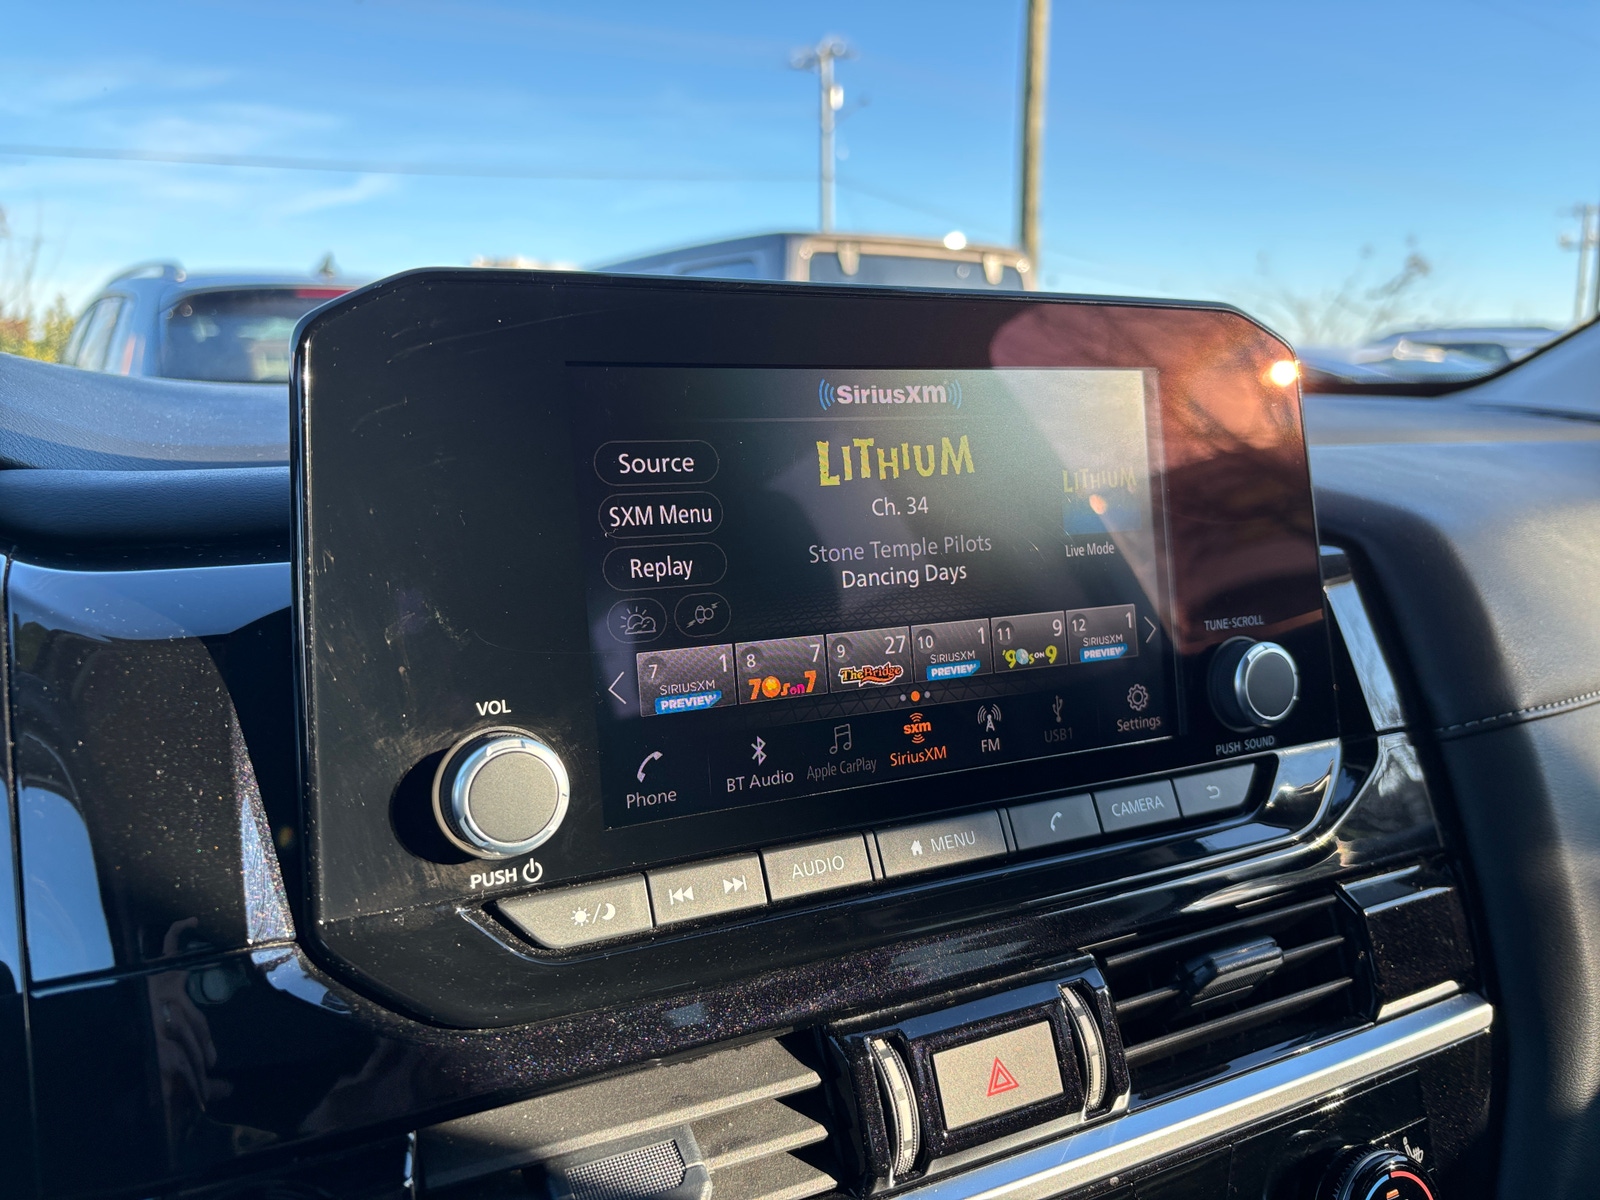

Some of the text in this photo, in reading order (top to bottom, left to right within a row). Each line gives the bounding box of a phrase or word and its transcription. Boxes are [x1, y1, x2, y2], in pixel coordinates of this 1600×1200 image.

[618, 453, 694, 473] Source
[872, 496, 929, 516] Ch. 34
[609, 504, 712, 527] SXM Menu
[809, 533, 992, 563] Stone Temple Pilots
[1065, 541, 1115, 557] Live Mode
[630, 555, 693, 582] Replay
[842, 563, 967, 590] Dancing Days
[1052, 619, 1063, 637] 9
[1071, 619, 1087, 633] 12
[1125, 612, 1133, 629] 1
[917, 635, 934, 650] 10
[977, 627, 985, 645] 1
[997, 627, 1011, 641] 11
[1082, 634, 1123, 647] SIRIUSXM
[810, 643, 820, 662] 7
[836, 644, 846, 658] 9
[884, 635, 906, 655] 27
[1083, 646, 1125, 659] PREVIEW
[719, 653, 727, 673] 1
[746, 653, 757, 668] 8
[930, 650, 976, 664] SIRIUSXM
[648, 664, 658, 679] 7
[931, 663, 977, 678] PREVIEW
[659, 679, 716, 696] SIRIUSXM
[804, 670, 817, 693] 7
[475, 700, 512, 717] VOL
[660, 694, 717, 710] PREVIEW
[903, 720, 932, 735] sxm
[1117, 715, 1161, 732] Settings
[1044, 726, 1073, 743] USB1
[981, 737, 1000, 753] FM
[1215, 735, 1275, 756] PUSH SOUND
[890, 745, 947, 766] SiriusXM
[806, 756, 877, 781] Apple CarPlay
[726, 770, 794, 793] BT Audio
[626, 789, 677, 809] Phone
[1111, 795, 1164, 818] CAMERA
[930, 831, 977, 853] MENU
[791, 855, 845, 880] AUDIO
[469, 869, 518, 889] PUSH
